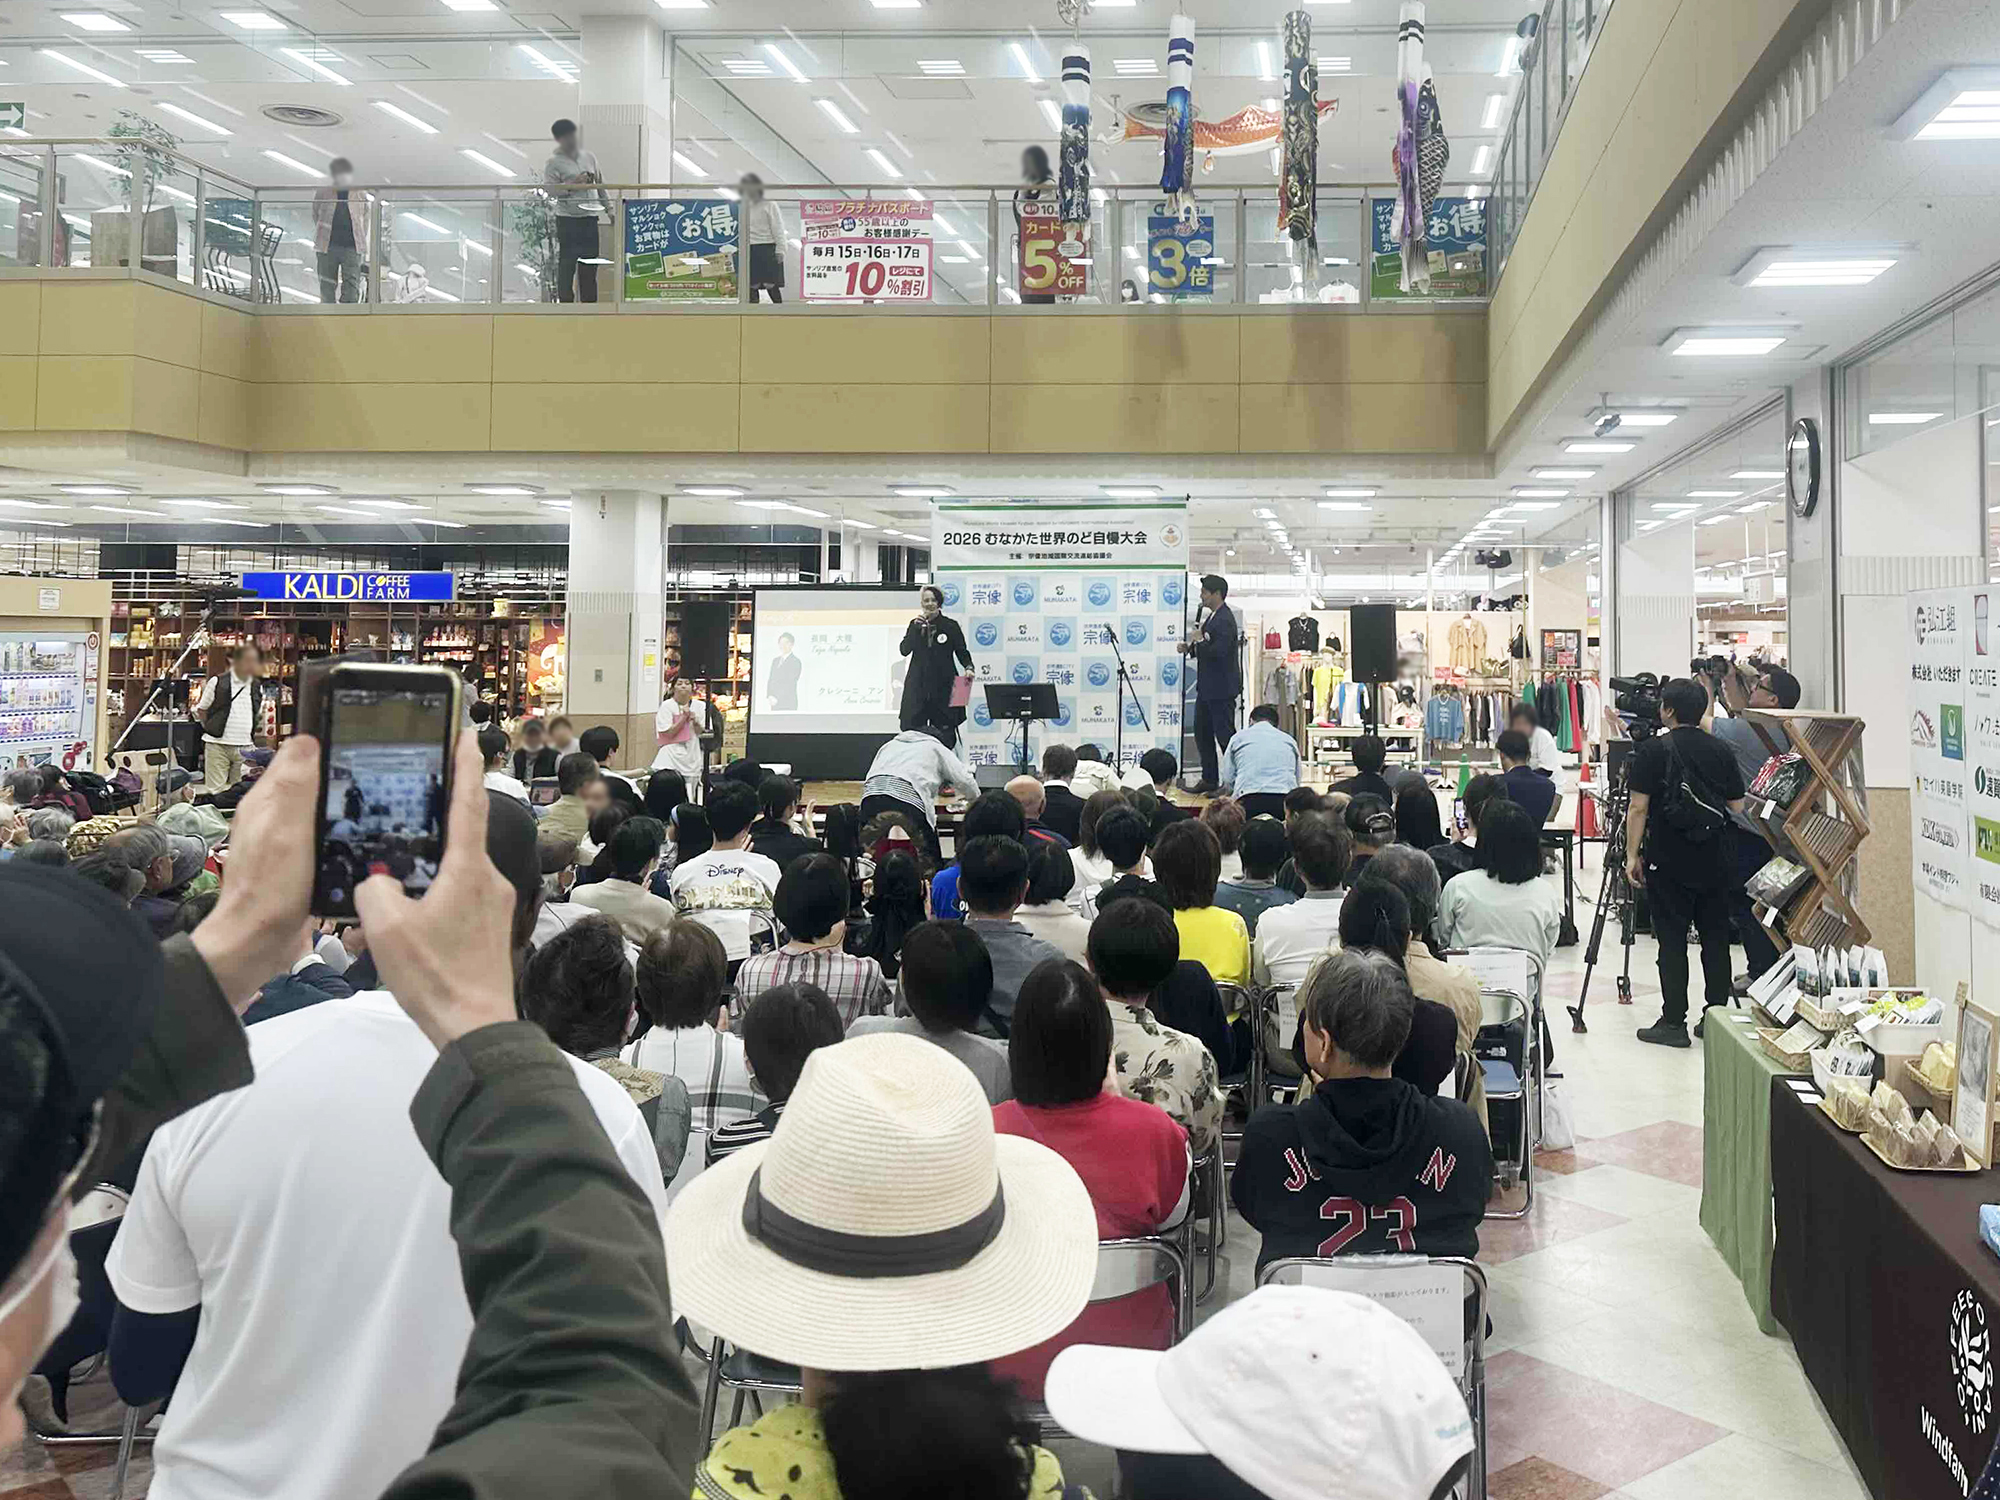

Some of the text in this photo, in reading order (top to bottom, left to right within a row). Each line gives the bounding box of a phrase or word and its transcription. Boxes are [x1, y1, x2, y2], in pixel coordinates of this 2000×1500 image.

[629, 203, 659, 215] サンリブ
[834, 201, 930, 215] プラチナパスポート
[631, 211, 667, 224] マルショク
[857, 216, 909, 227] 55歳以上の
[634, 230, 670, 243] お買物は
[864, 228, 930, 238] お客様感謝デー
[636, 239, 670, 253] カードが
[812, 246, 835, 258] 毎月
[891, 266, 923, 276] レジにて
[1058, 276, 1085, 289] OFF
[943, 530, 1148, 546] 2026 むなかた世界のど自慢大会
[284, 574, 411, 600] KALDI COFFEE
[366, 587, 411, 599] FARM
[972, 590, 1002, 605] 宗像
[1123, 588, 1151, 604] 宗像
[1046, 670, 1075, 685] 宗像
[867, 687, 884, 695] アン
[1157, 710, 1181, 726] 宗像
[969, 751, 998, 766] 宗像
[705, 863, 745, 878] Disney
[1316, 1195, 1418, 1258] 23
